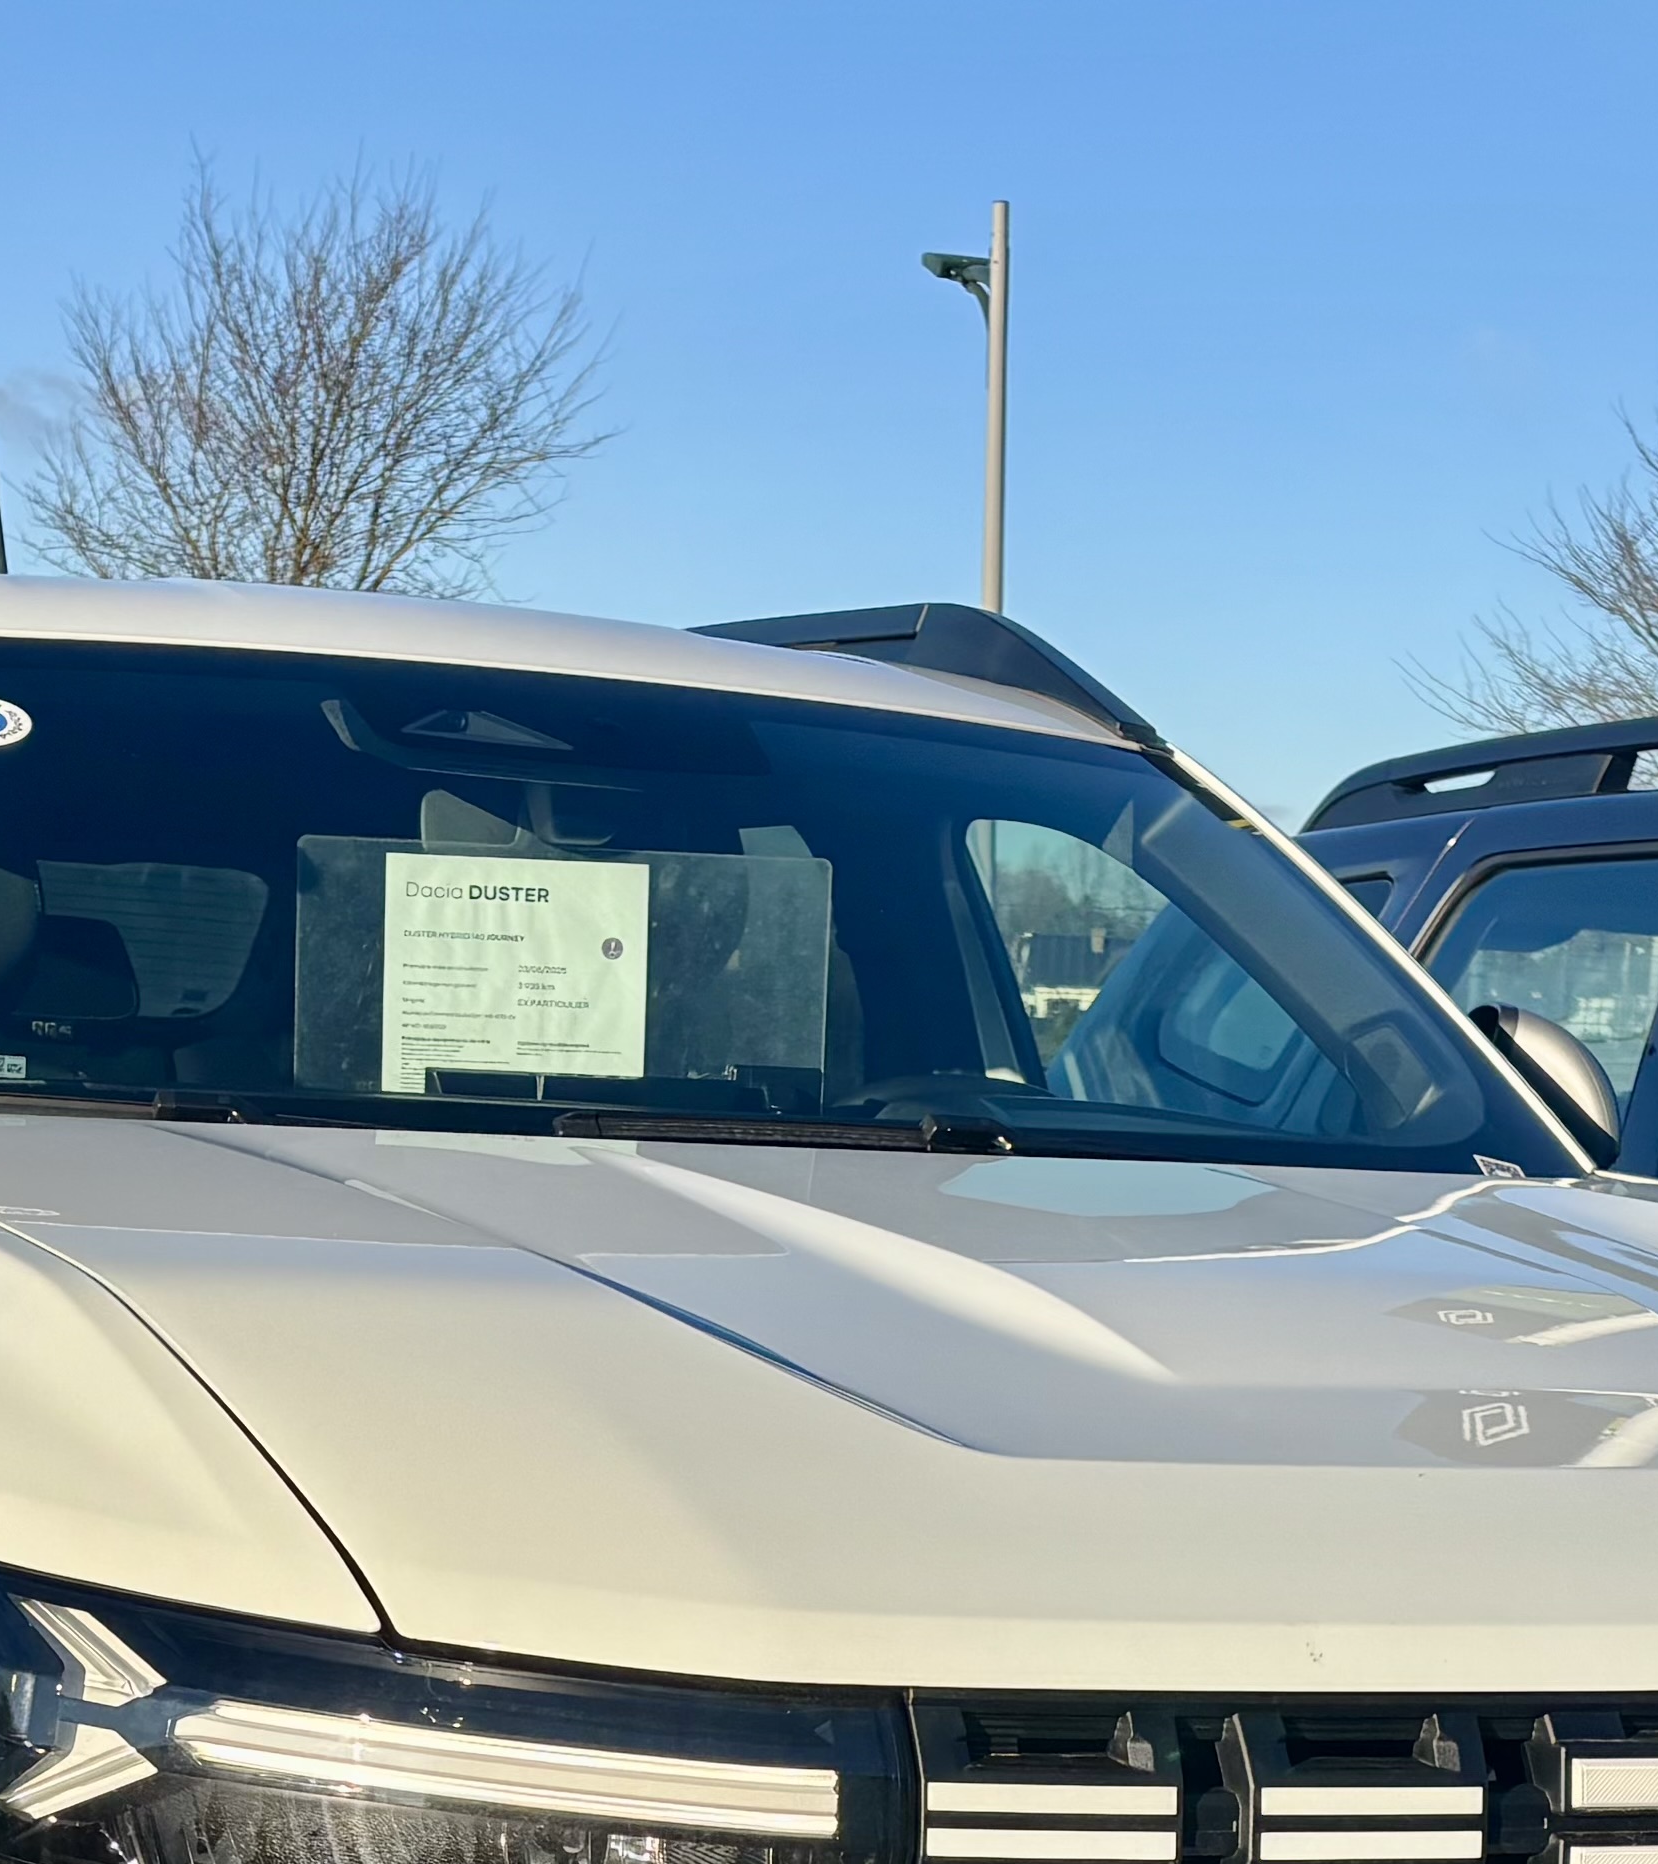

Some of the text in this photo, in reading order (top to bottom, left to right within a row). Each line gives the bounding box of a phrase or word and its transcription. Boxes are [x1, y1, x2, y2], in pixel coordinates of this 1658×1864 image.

[405, 881, 550, 903] Dacia DUSTER
[403, 929, 437, 938] DUSTER
[486, 933, 525, 942] JOURNEY
